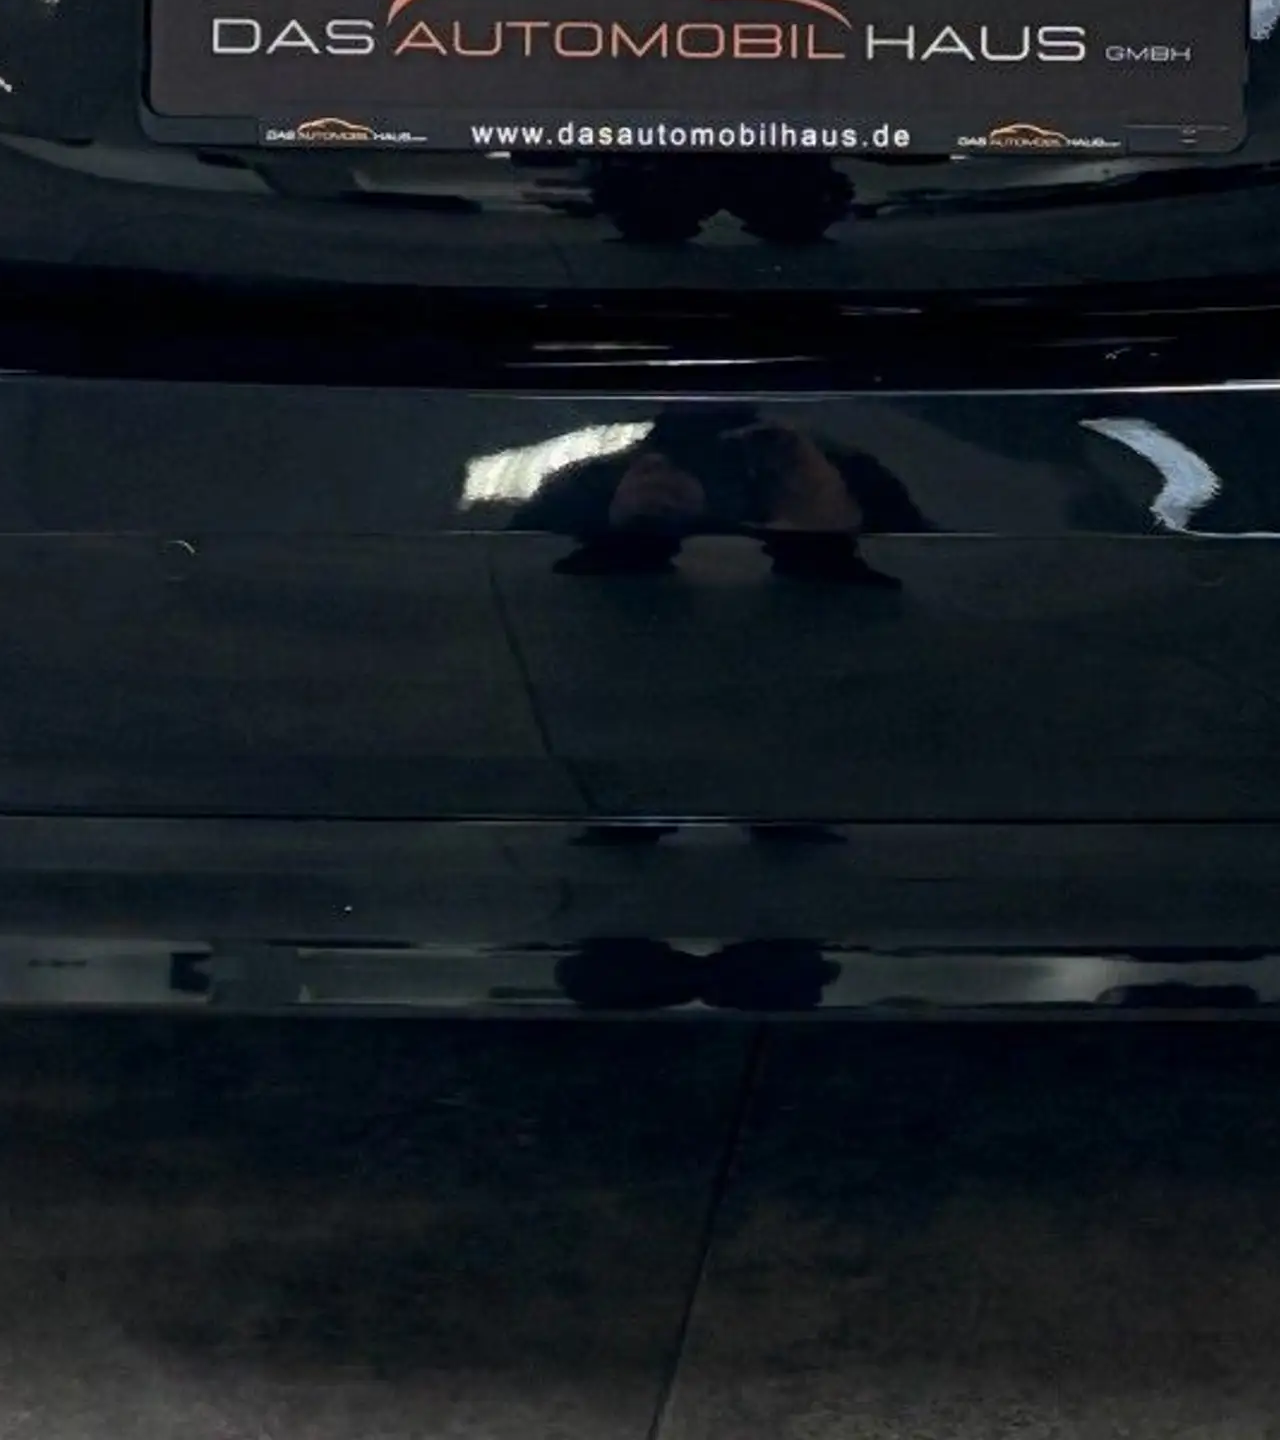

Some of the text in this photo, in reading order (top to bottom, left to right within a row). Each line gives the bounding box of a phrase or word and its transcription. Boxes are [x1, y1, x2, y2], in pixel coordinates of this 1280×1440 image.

[211, 18, 1192, 62] DAS AUTOMOBIL HAUS GMBH
[470, 122, 911, 148] www.dasautomobilhaus.de
